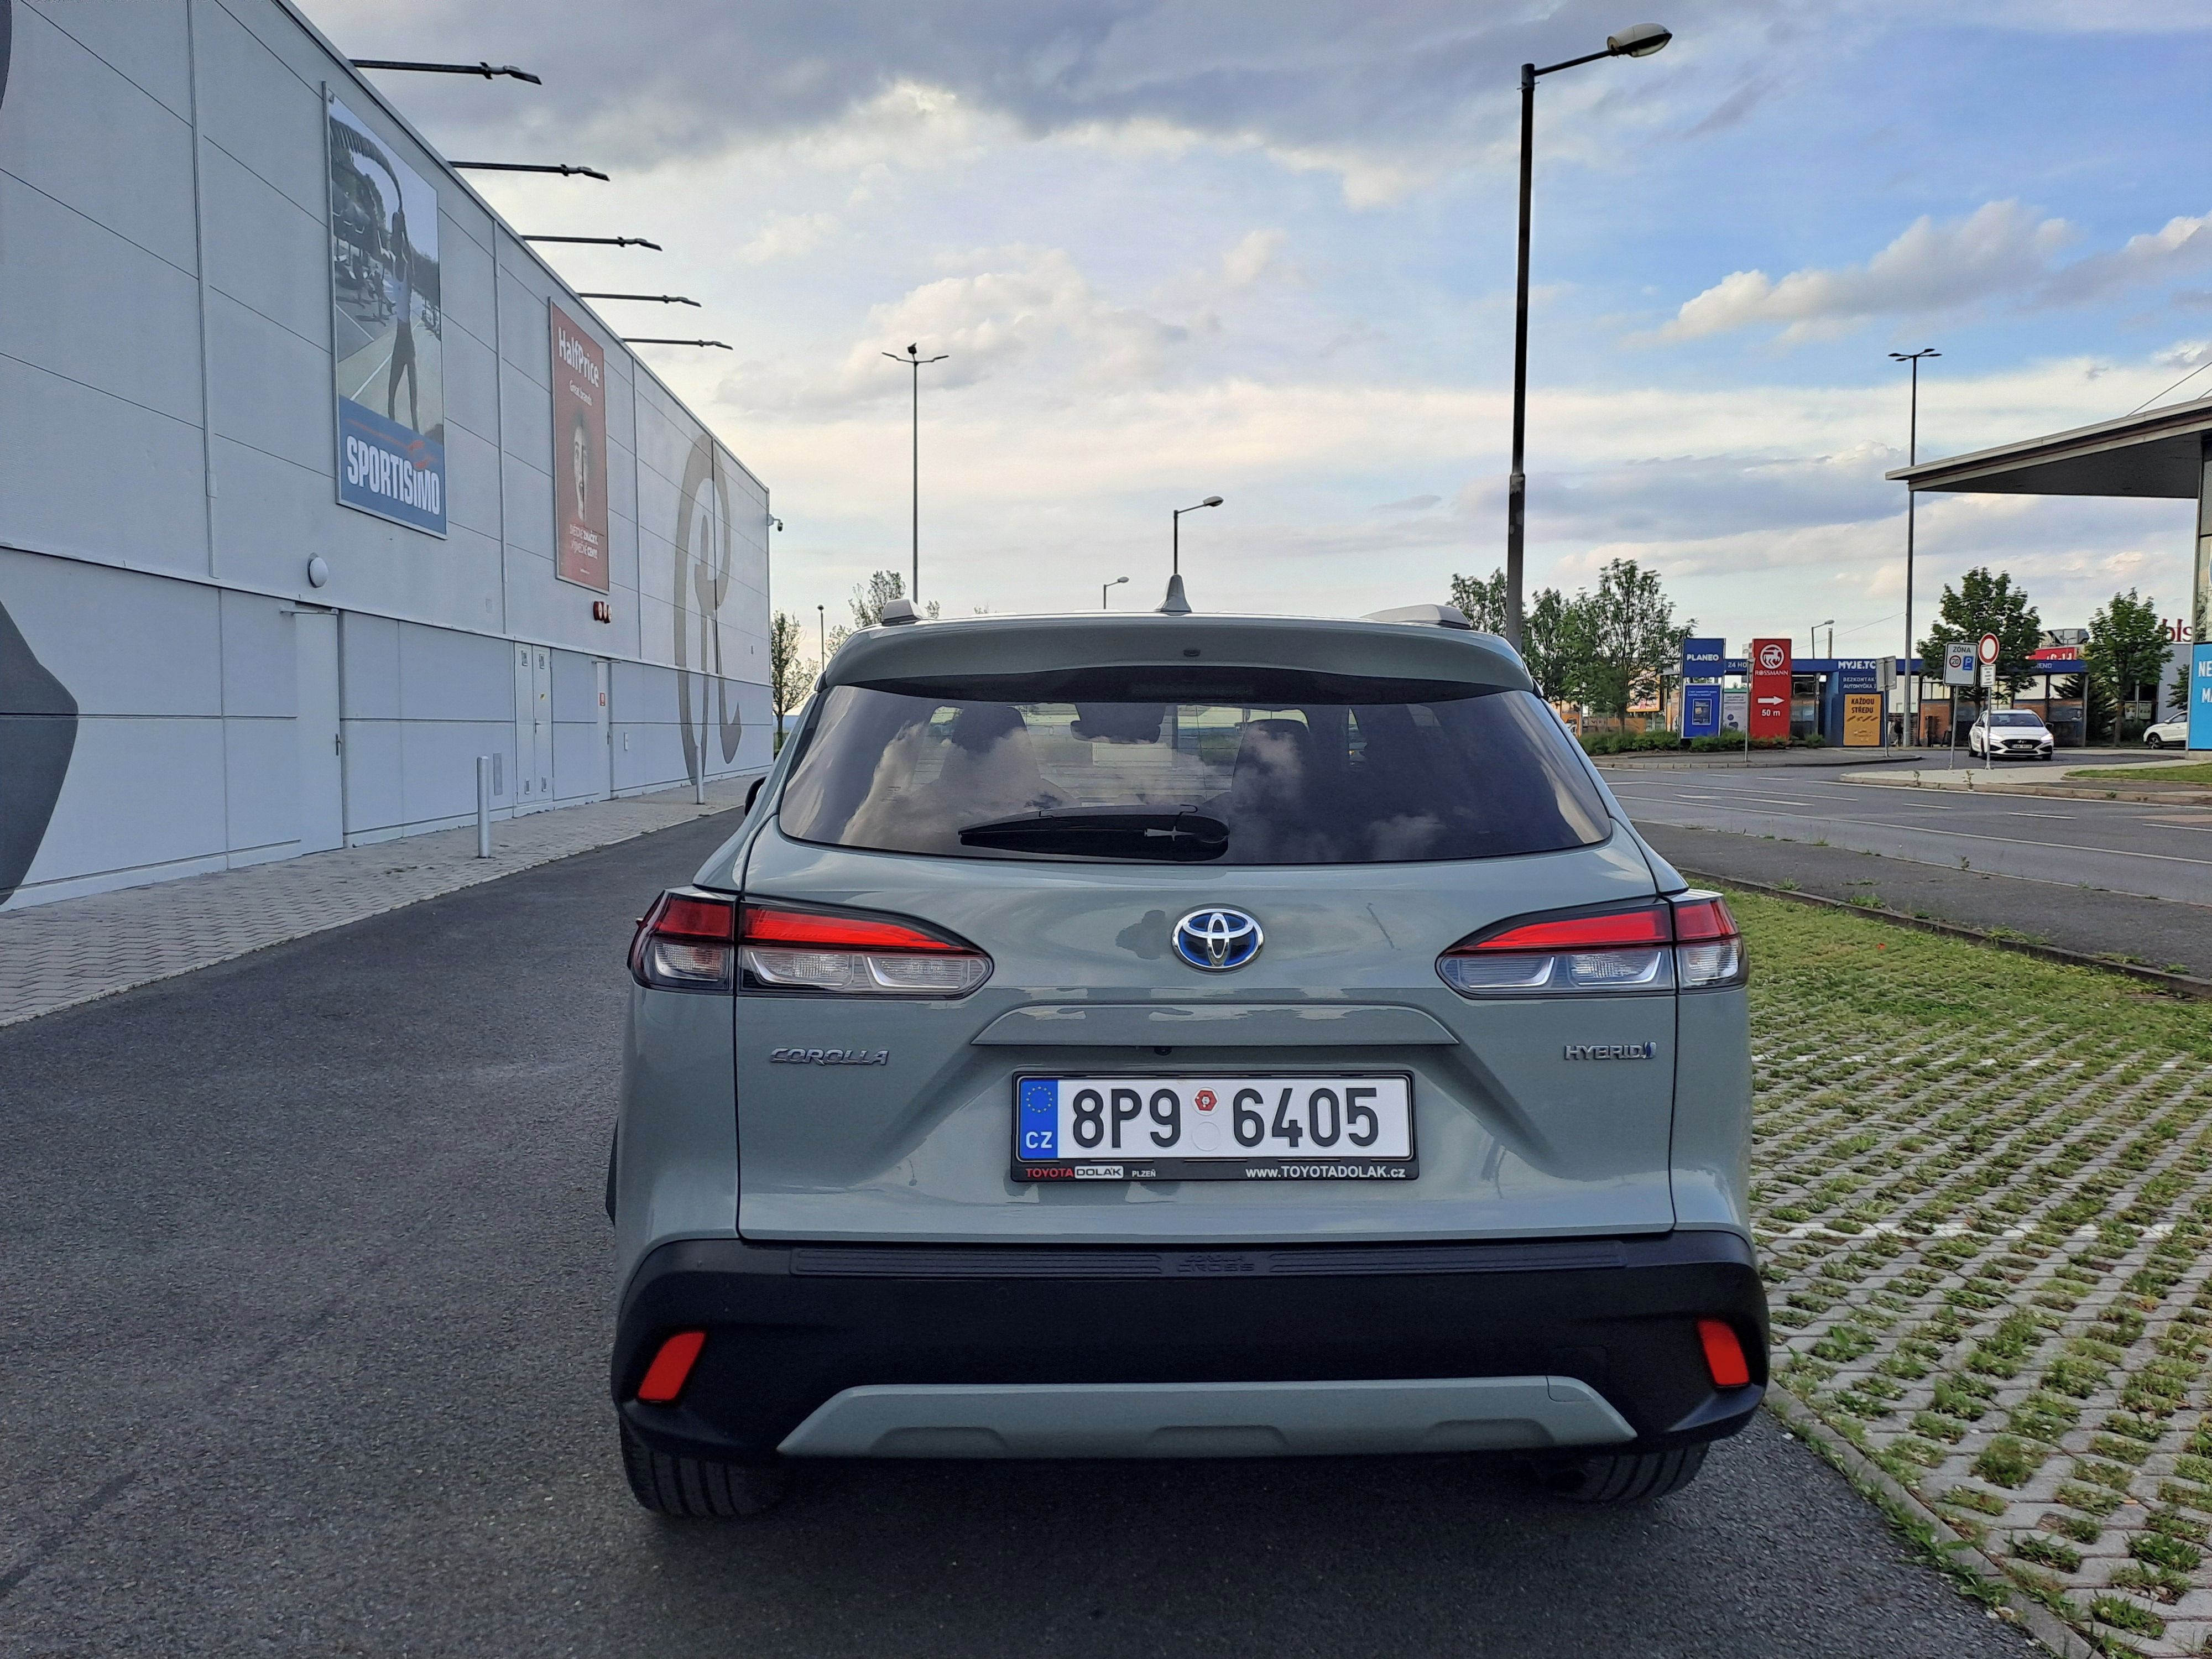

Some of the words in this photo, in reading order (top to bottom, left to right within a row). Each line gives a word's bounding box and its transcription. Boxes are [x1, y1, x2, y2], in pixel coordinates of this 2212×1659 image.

[558, 326, 599, 388] HalfPrice
[346, 435, 441, 516] SPORTISIMO
[770, 1047, 889, 1066] COROLLA
[1564, 1045, 1645, 1060] HYBRID
[1072, 1088, 1182, 1149] 8P9
[1233, 1087, 1379, 1147] 6405
[1025, 1131, 1053, 1149] CZ
[1025, 1167, 1074, 1178] TOYOTA
[1131, 1168, 1156, 1178] PLZEŇ
[1245, 1166, 1406, 1178] www.TOYOTADOLAK.cz
[1177, 1264, 1255, 1272] CROSS
